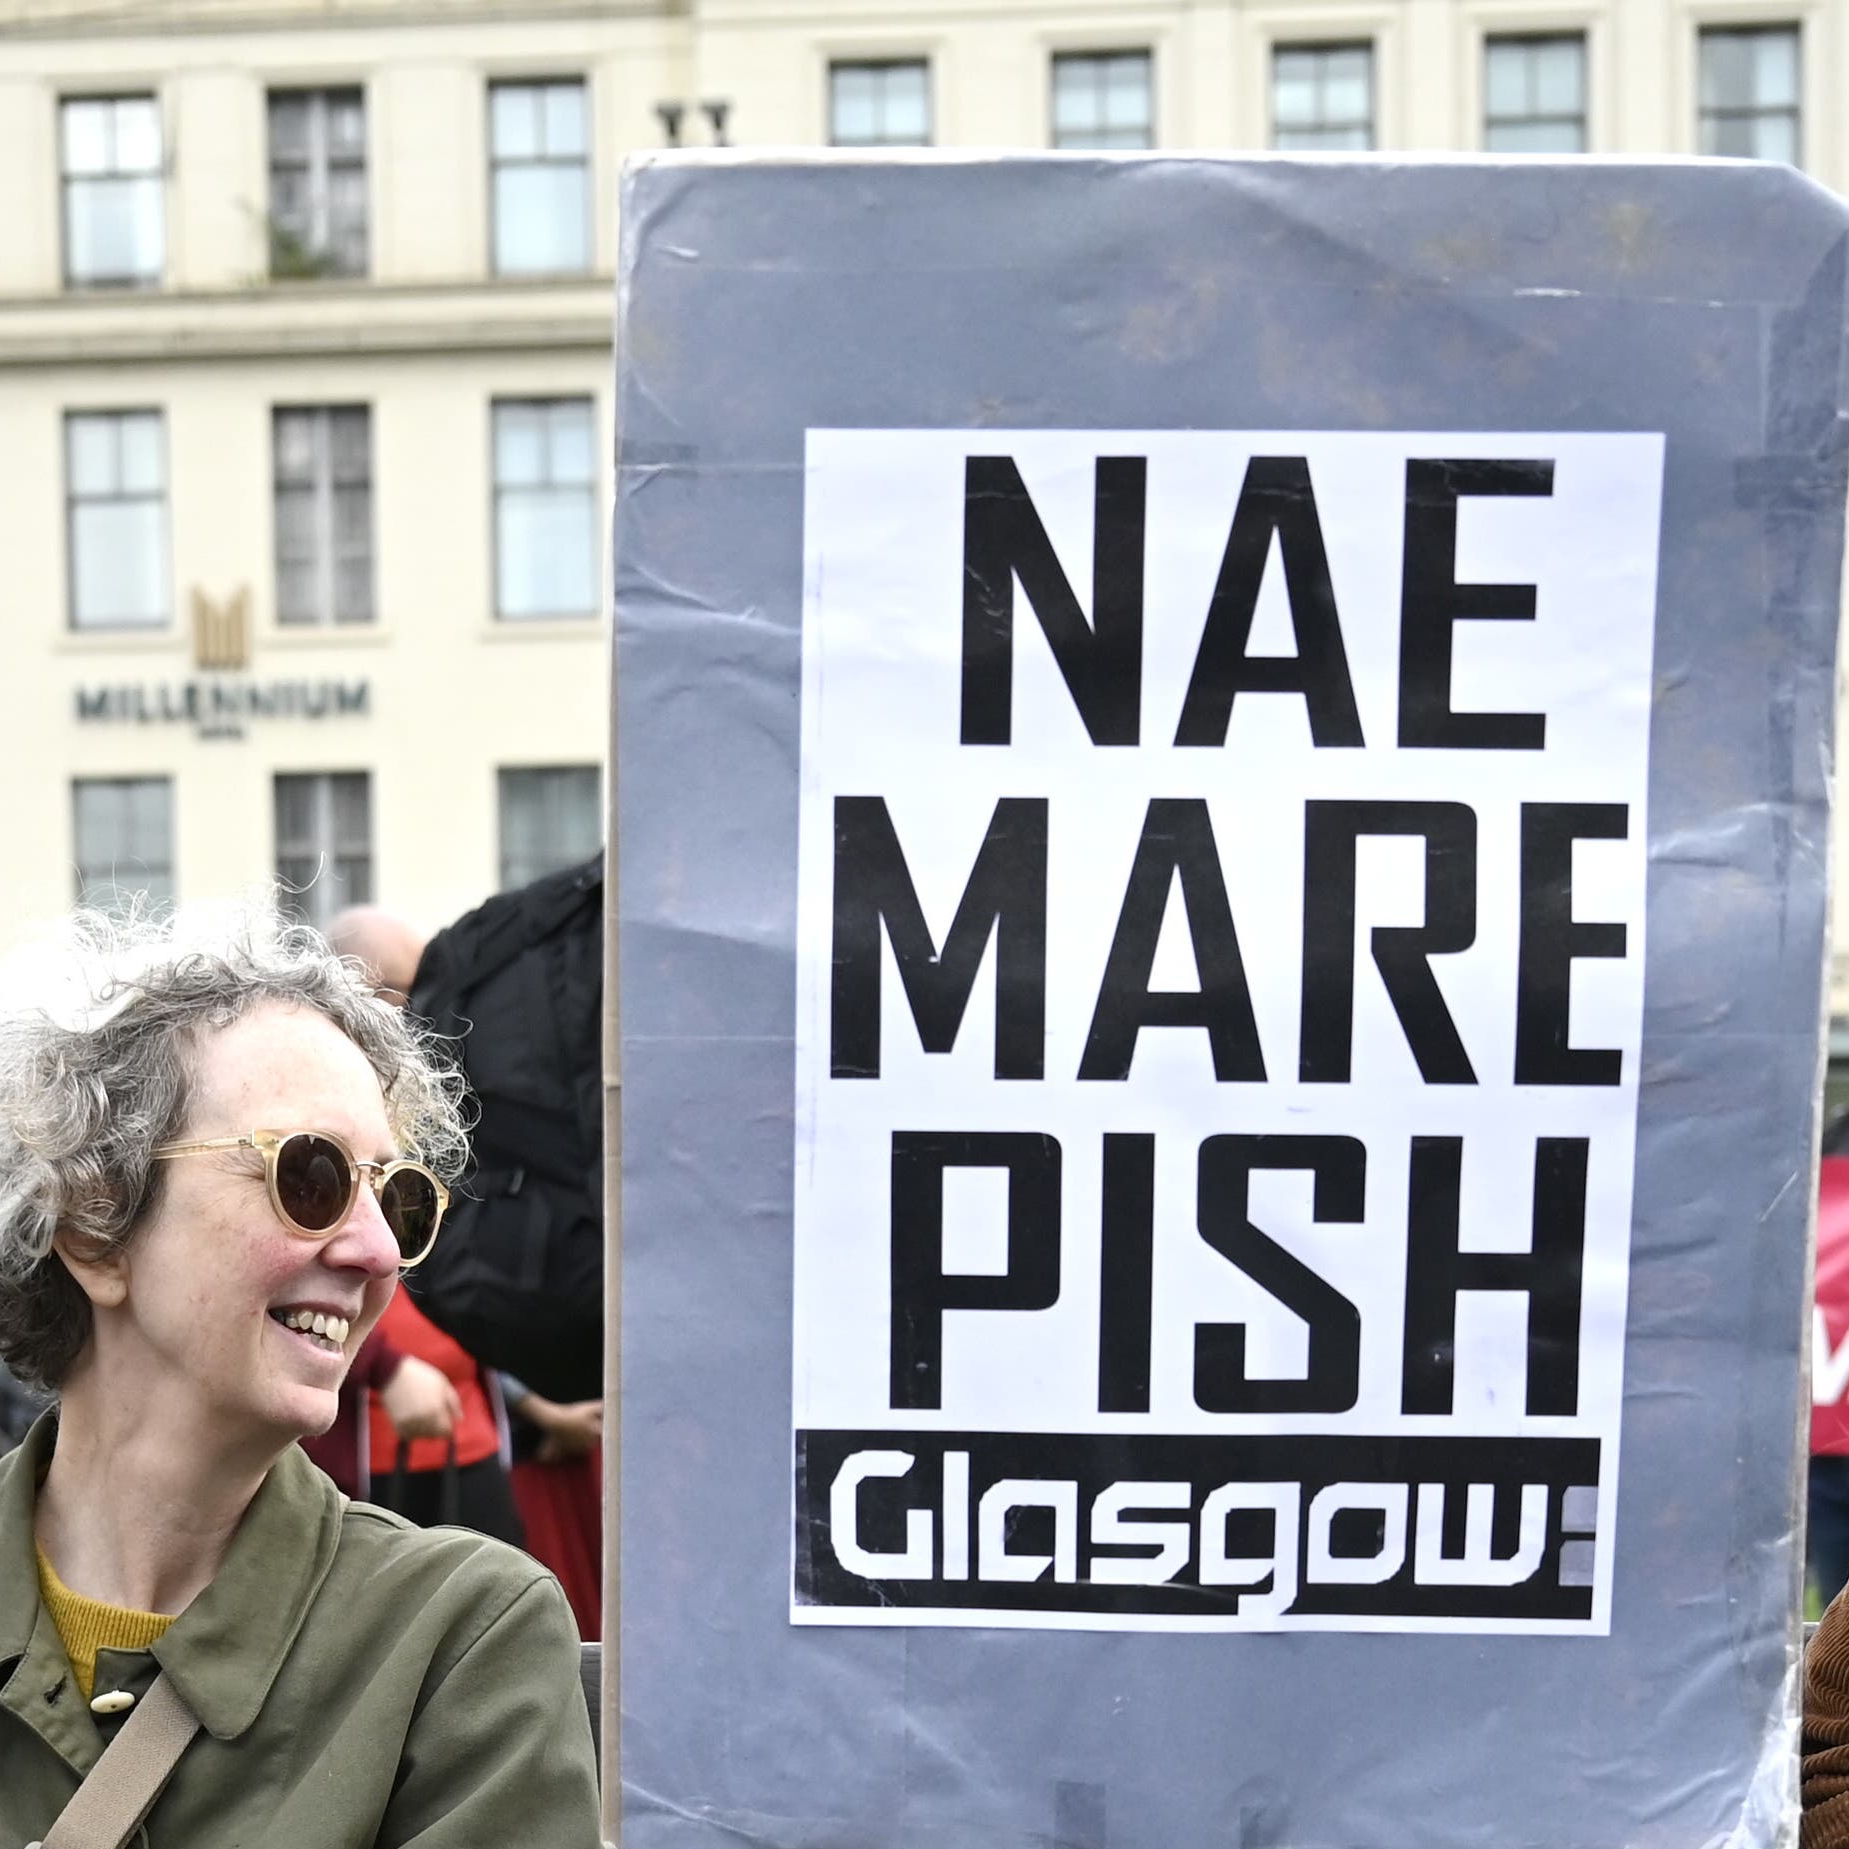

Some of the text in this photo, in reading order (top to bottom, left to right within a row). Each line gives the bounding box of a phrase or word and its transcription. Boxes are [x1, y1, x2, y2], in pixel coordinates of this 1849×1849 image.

[74, 676, 370, 724] MILLENNIUM
[959, 455, 1555, 751] NAE
[829, 795, 1630, 1087] MARE
[888, 1129, 1591, 1418] PISH
